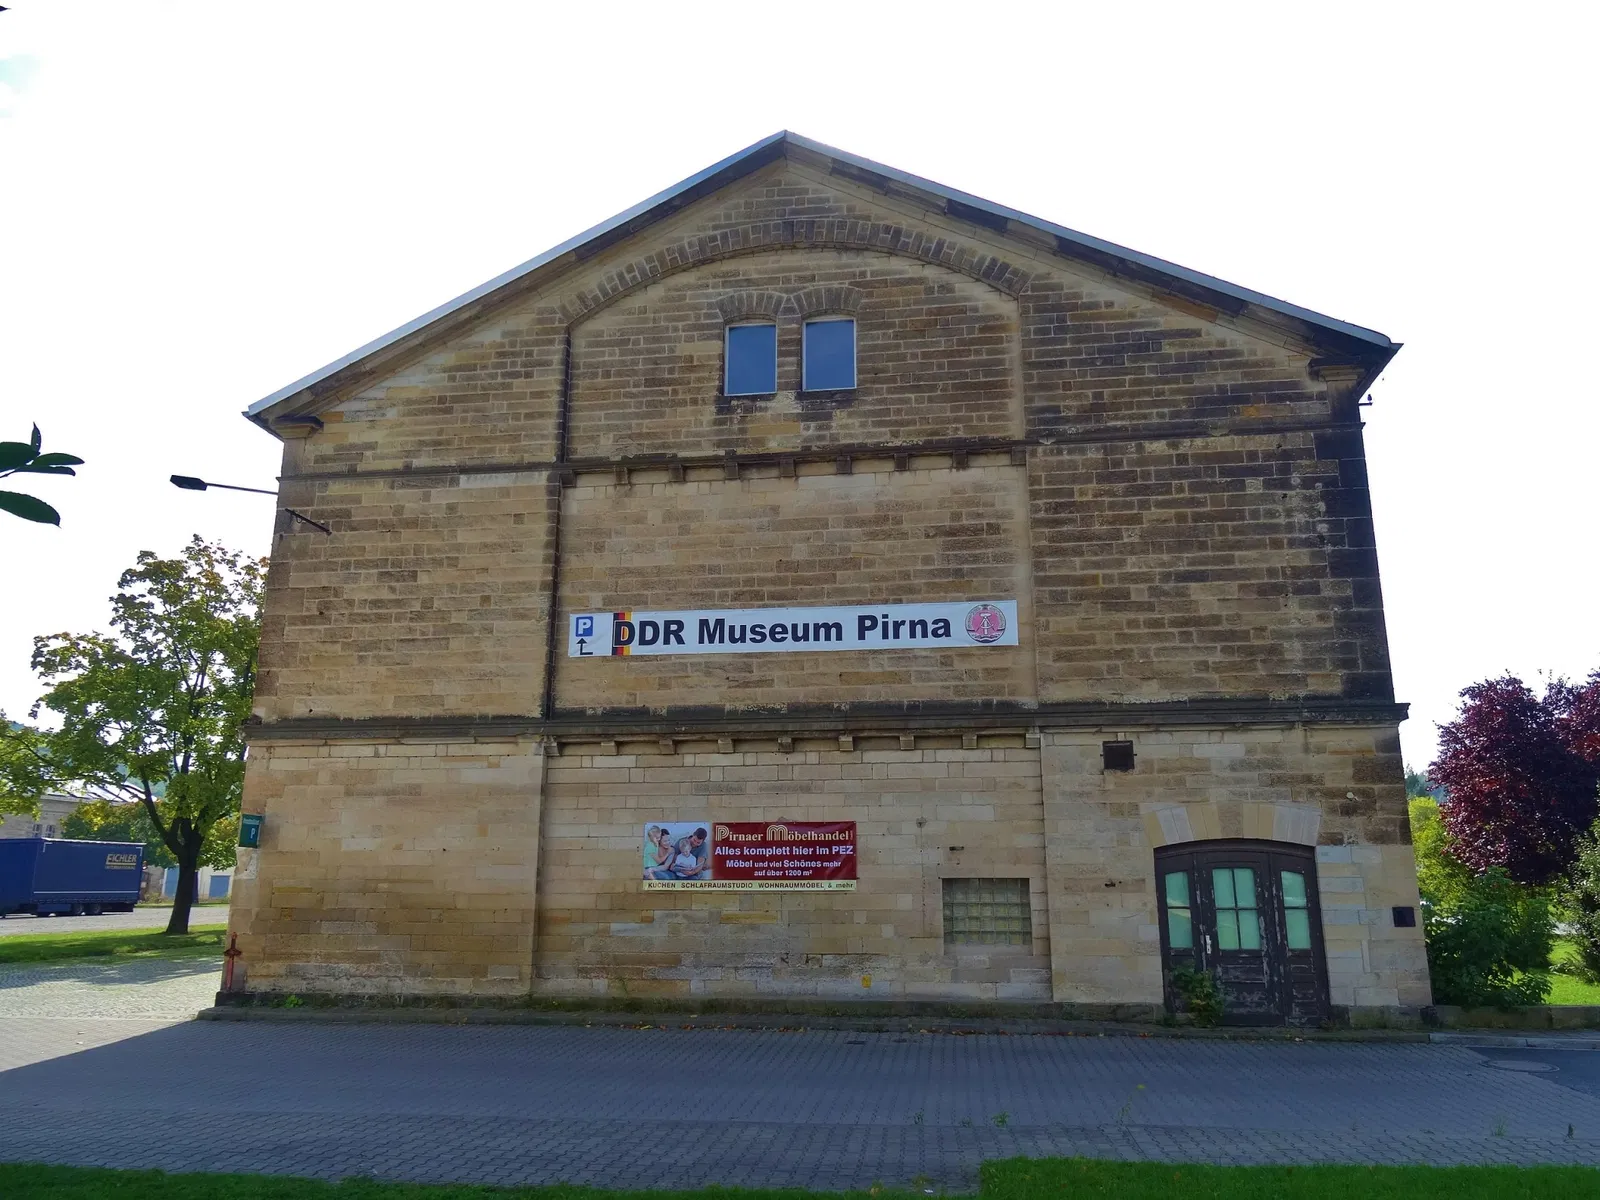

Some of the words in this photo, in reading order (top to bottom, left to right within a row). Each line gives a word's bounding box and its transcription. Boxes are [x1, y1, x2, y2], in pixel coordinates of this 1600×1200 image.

[578, 619, 592, 635] P
[614, 620, 685, 646] DDR
[698, 618, 843, 645] Museum
[857, 614, 952, 641] Pirna
[715, 825, 763, 842] Pirnaer
[766, 825, 849, 841] Möbelhandel
[715, 847, 741, 855] Alles
[743, 846, 790, 857] komplett
[793, 846, 814, 855] hier
[816, 845, 829, 855] im
[832, 845, 854, 855] PEZ
[106, 853, 137, 865] EICHLER
[726, 860, 753, 868] Möbel
[783, 860, 822, 868] Schönes
[767, 869, 784, 877] über
[785, 869, 802, 877] 1200
